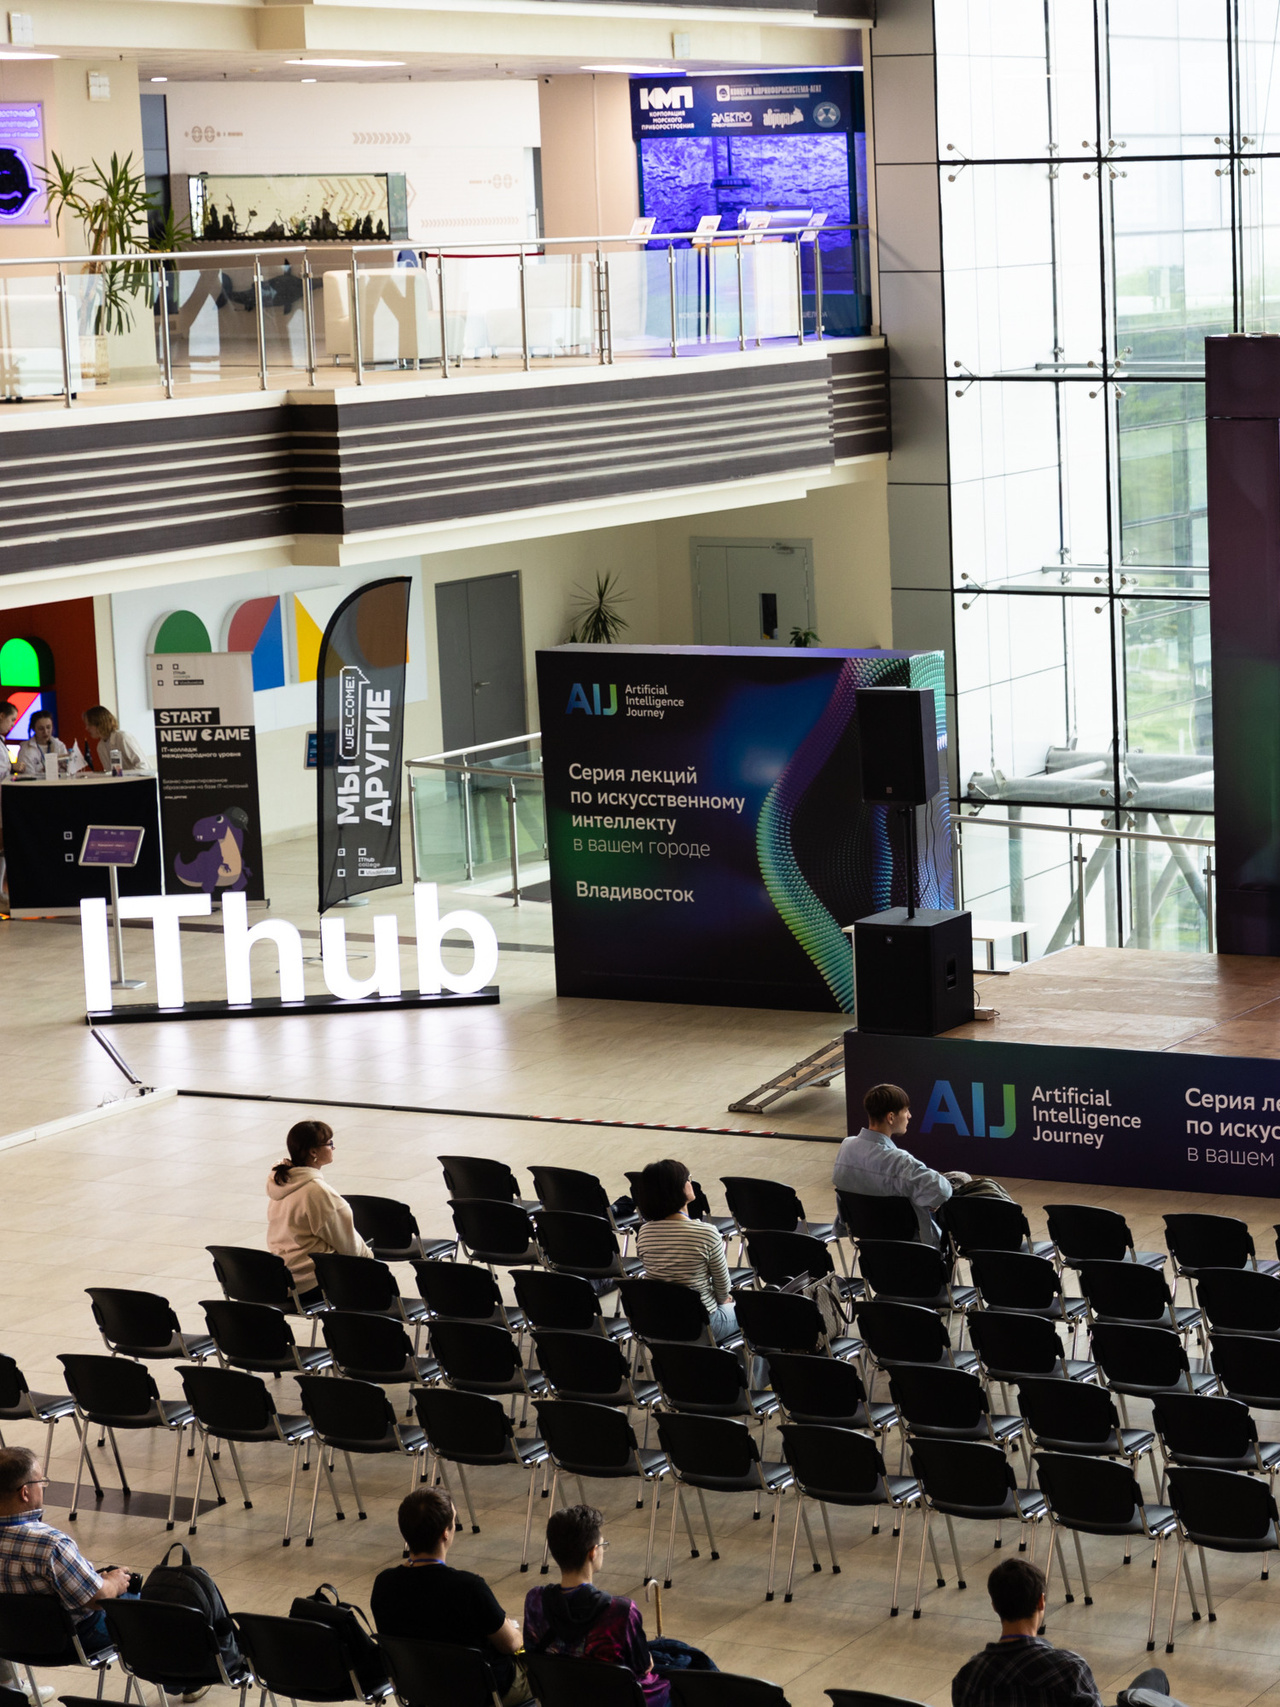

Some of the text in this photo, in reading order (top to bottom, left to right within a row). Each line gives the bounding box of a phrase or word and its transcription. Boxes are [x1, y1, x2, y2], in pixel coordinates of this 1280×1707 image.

[640, 86, 694, 110] КМП
[649, 110, 685, 118] КОРПОРАЦИЯ
[652, 116, 682, 124] МОРСКОГО
[712, 112, 752, 123] ЭЛЕКТРО
[565, 683, 618, 715] AIJ
[625, 684, 668, 695] Artificial
[626, 696, 684, 708] Intelligence
[160, 711, 212, 724] START
[345, 676, 355, 750] WELCOME!
[626, 708, 664, 719] Journey
[161, 730, 197, 742] NEW
[365, 689, 392, 826] ДРУГИЕ
[569, 763, 697, 786] Серия лекций
[337, 765, 360, 825] МЫ
[571, 791, 745, 814] по искусственному
[572, 815, 676, 835] интеллекту
[573, 838, 710, 858] в вашем городе
[576, 881, 694, 902] Владивосток
[80, 882, 499, 1011] IThub
[1032, 1086, 1112, 1107] Artificial
[1185, 1088, 1255, 1113] Серия
[919, 1080, 1016, 1139] AIJ
[1033, 1106, 1142, 1129] Intelligence
[1033, 1126, 1104, 1149] Journey
[1187, 1120, 1212, 1135] по
[1188, 1148, 1199, 1162] в
[1206, 1148, 1274, 1167] вашем
